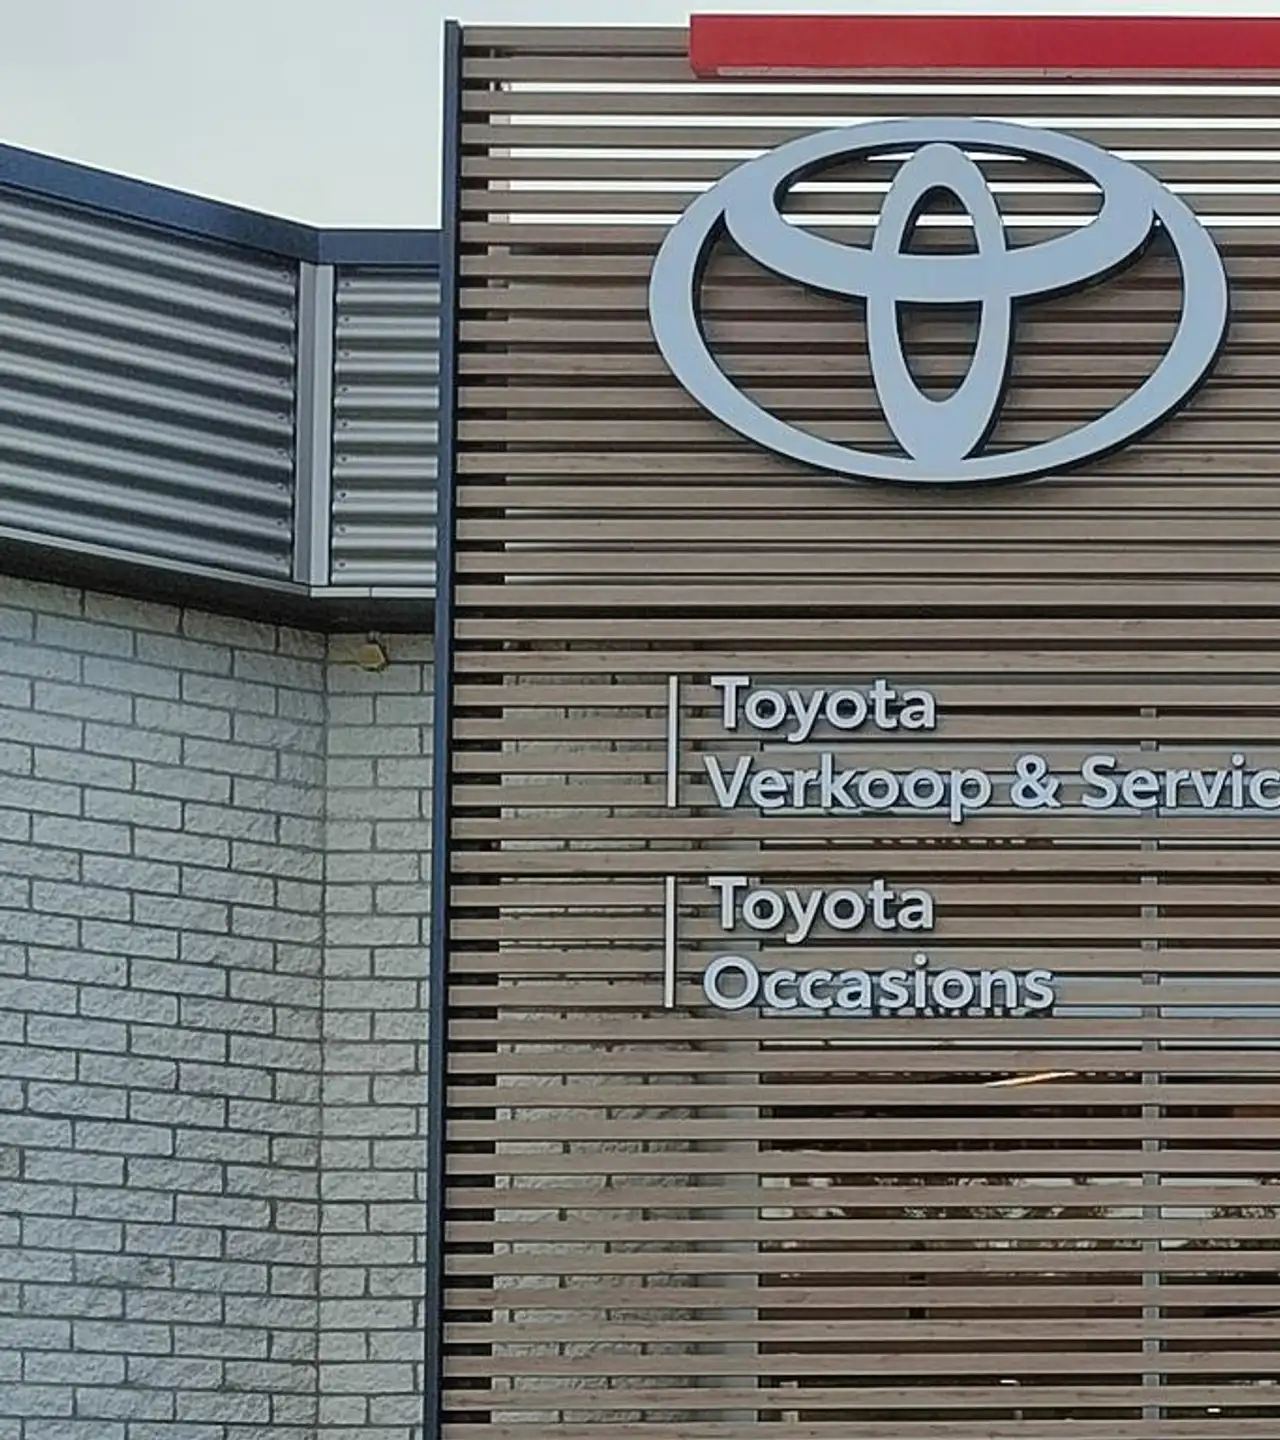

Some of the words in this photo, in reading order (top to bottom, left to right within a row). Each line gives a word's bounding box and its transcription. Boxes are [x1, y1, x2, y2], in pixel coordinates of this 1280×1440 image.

[711, 676, 936, 743] Toyota
[703, 752, 992, 823] Verkoop
[1010, 753, 1062, 808] &
[708, 876, 934, 944] Toyota
[703, 952, 1055, 1010] Occasions
